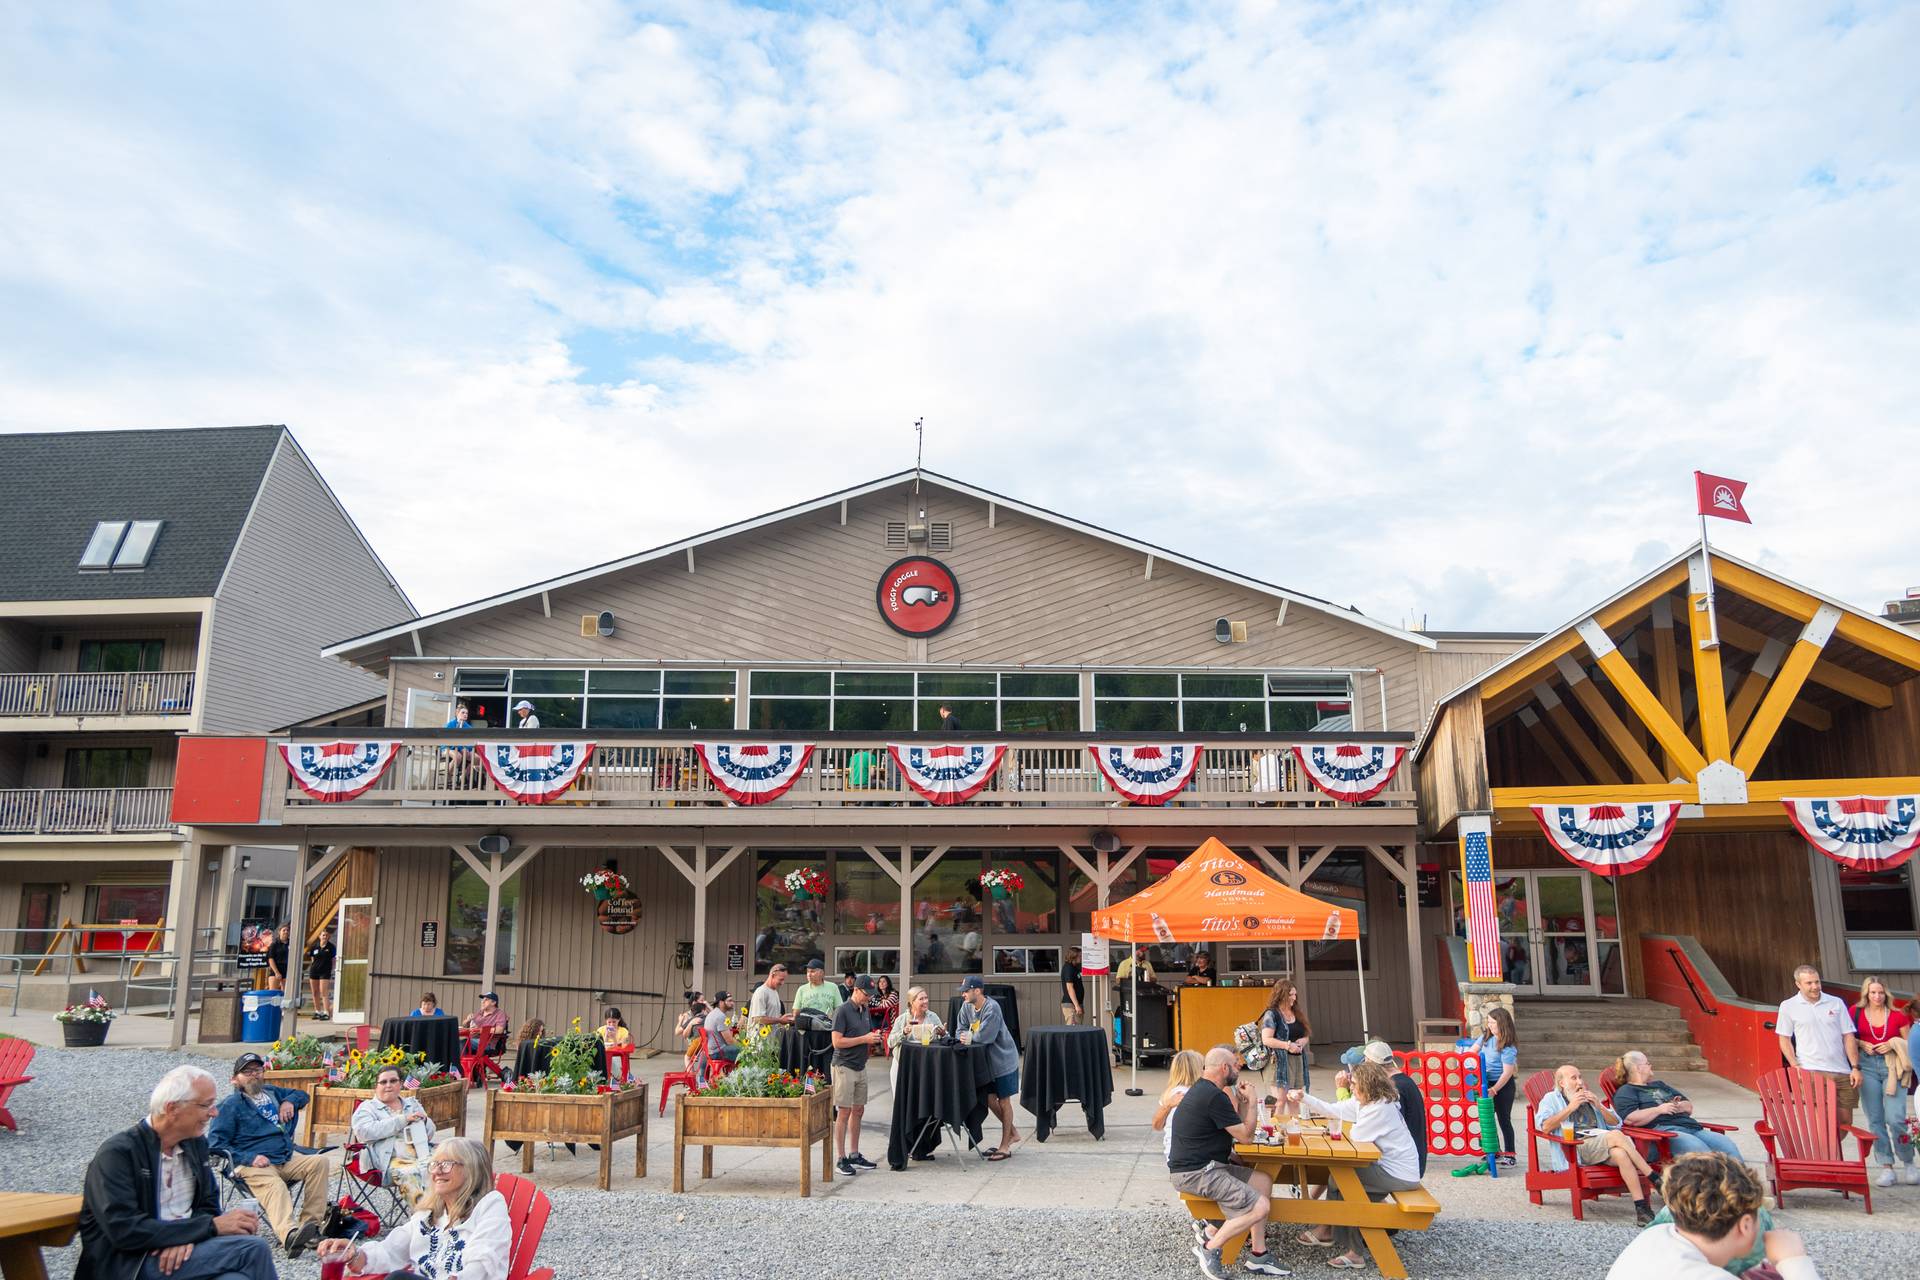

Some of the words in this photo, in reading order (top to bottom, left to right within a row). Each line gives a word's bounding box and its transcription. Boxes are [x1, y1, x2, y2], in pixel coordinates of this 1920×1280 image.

[894, 570, 919, 588] GOGGLE
[890, 587, 899, 612] FOGGY
[1200, 856, 1244, 872] Tito's
[1204, 887, 1265, 898] Handmade
[608, 898, 633, 906] Coffee
[1201, 915, 1240, 931] Tito's
[1262, 915, 1296, 924] Handmade
